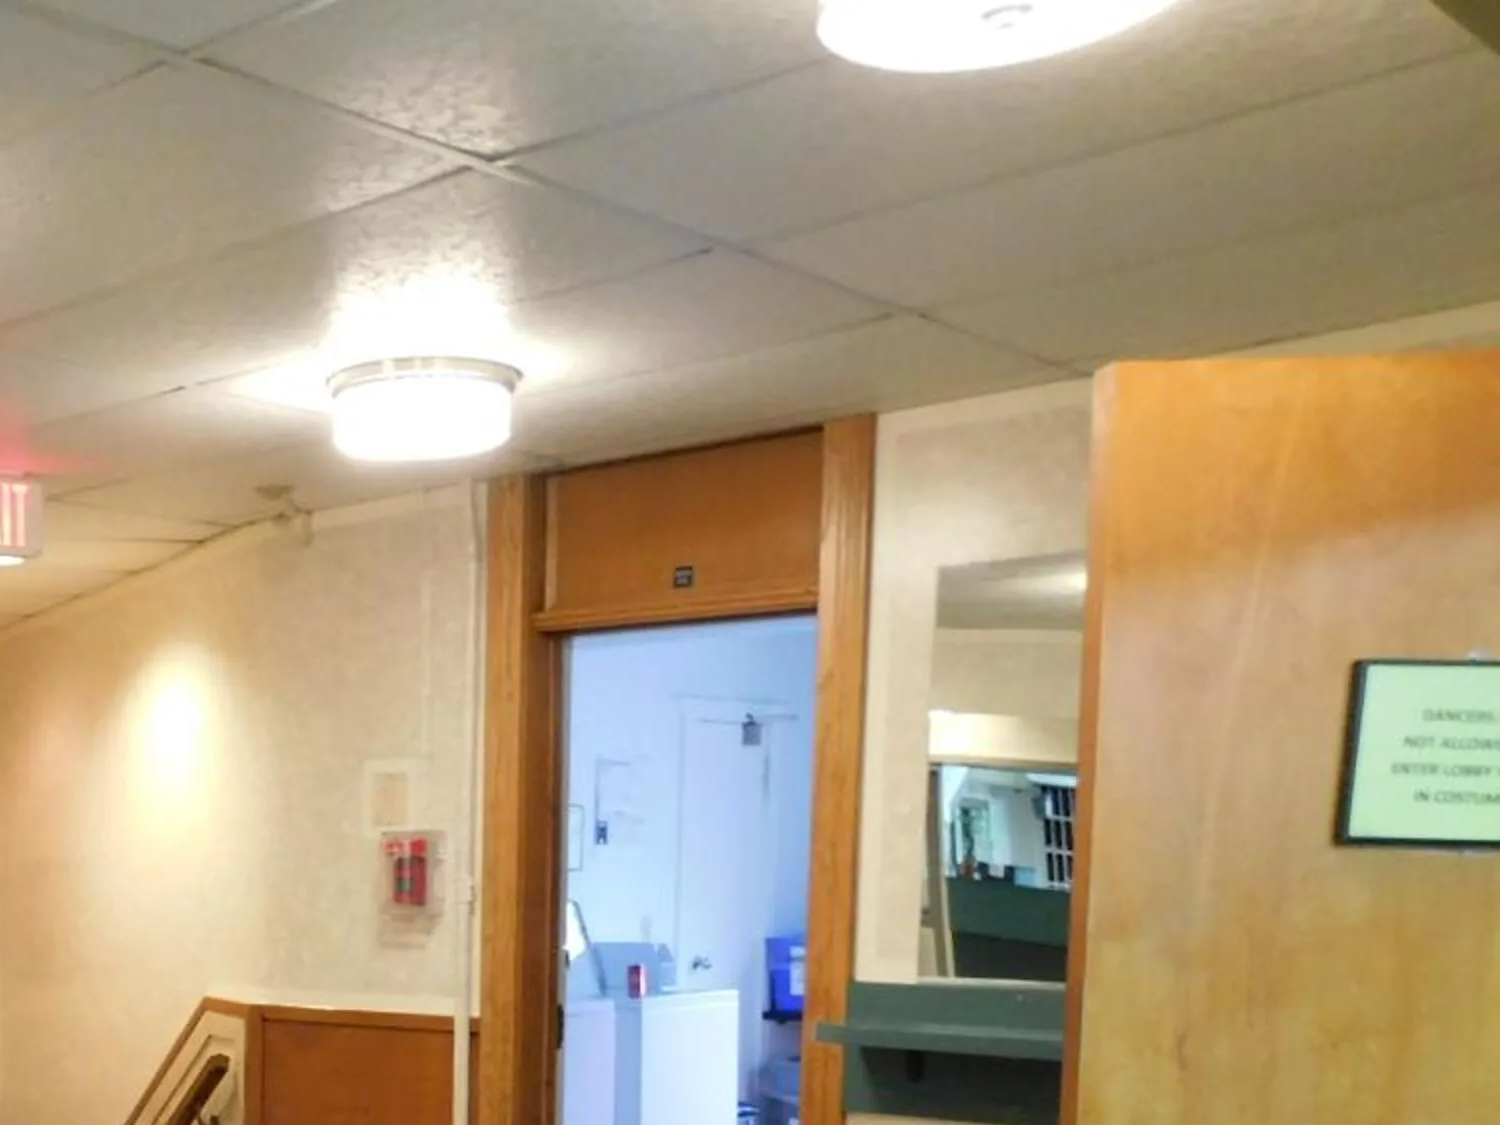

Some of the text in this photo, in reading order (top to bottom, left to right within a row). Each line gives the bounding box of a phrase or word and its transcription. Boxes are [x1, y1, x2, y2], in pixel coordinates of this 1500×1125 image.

[1423, 709, 1494, 722] DANCERS
[1403, 736, 1500, 751] NOT ALLOWE
[1391, 763, 1439, 775] ENTER
[1443, 765, 1491, 777] LOBBY
[1413, 788, 1500, 805] IN COSTUM
